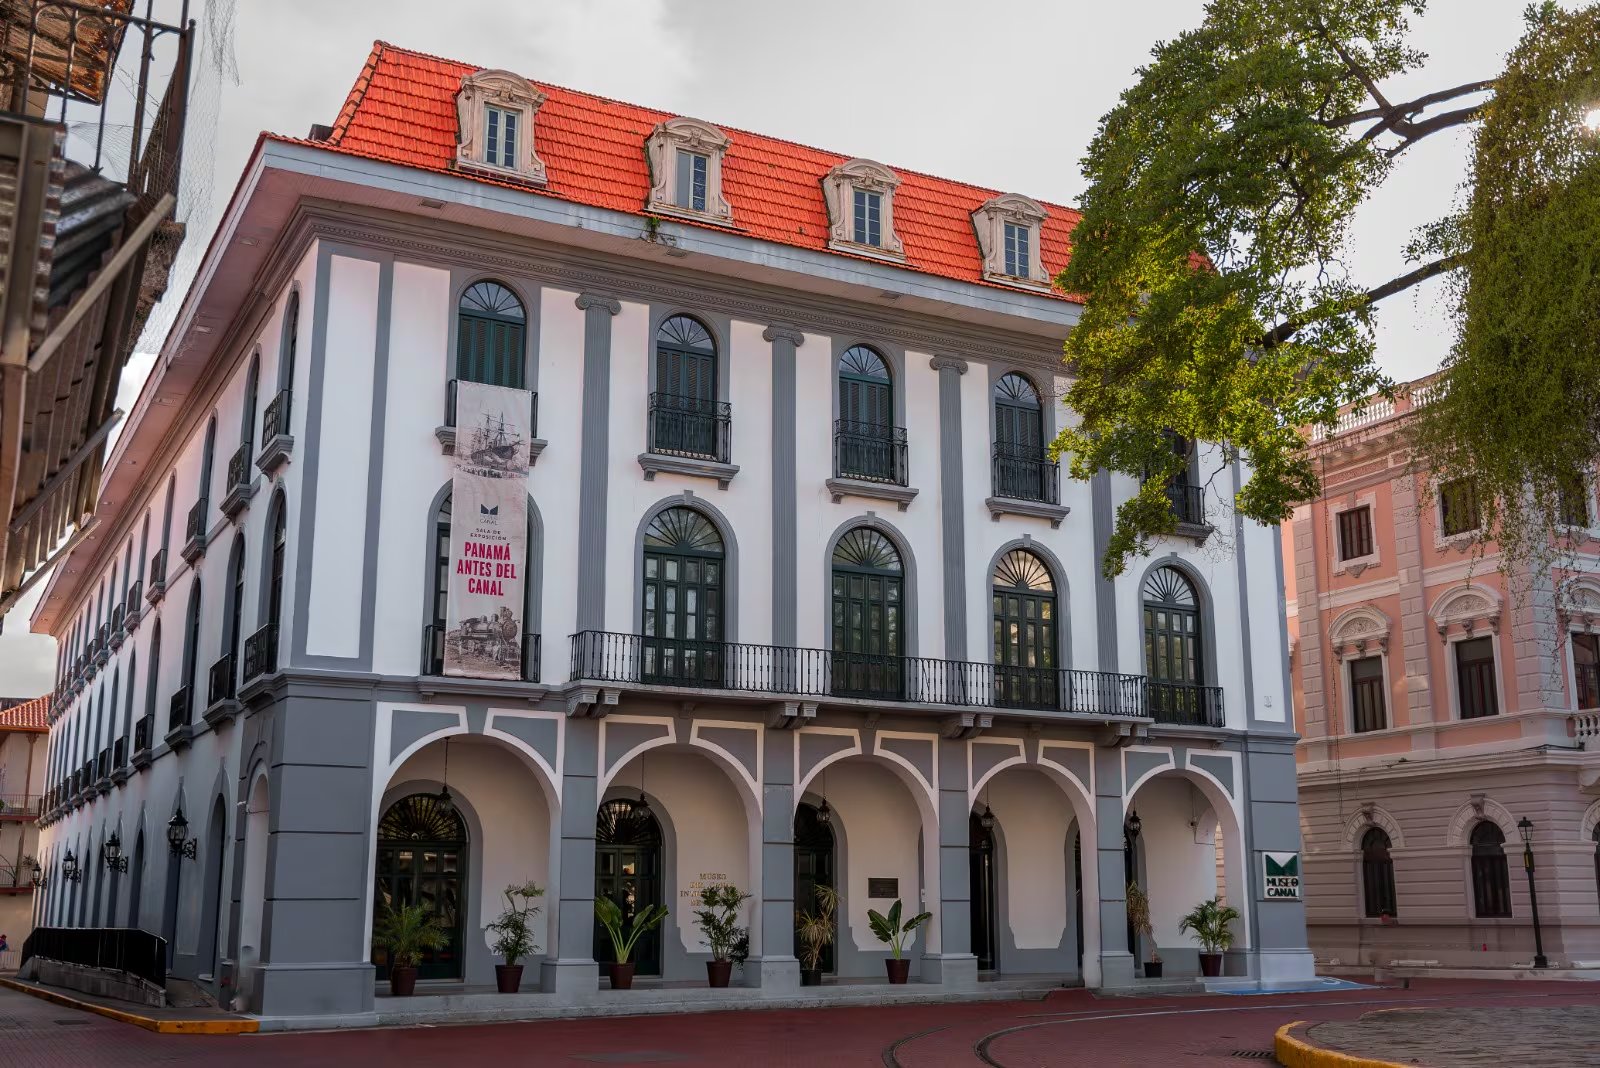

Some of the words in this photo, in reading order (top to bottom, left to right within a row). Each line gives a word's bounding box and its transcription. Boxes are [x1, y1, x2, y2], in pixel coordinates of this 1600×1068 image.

[464, 541, 511, 560] PANAMÁ
[457, 559, 491, 577] ANTES
[496, 563, 517, 579] DEL
[468, 578, 504, 596] CANAL
[1266, 878, 1299, 887] MUSEO
[1267, 887, 1298, 897] CANAL
